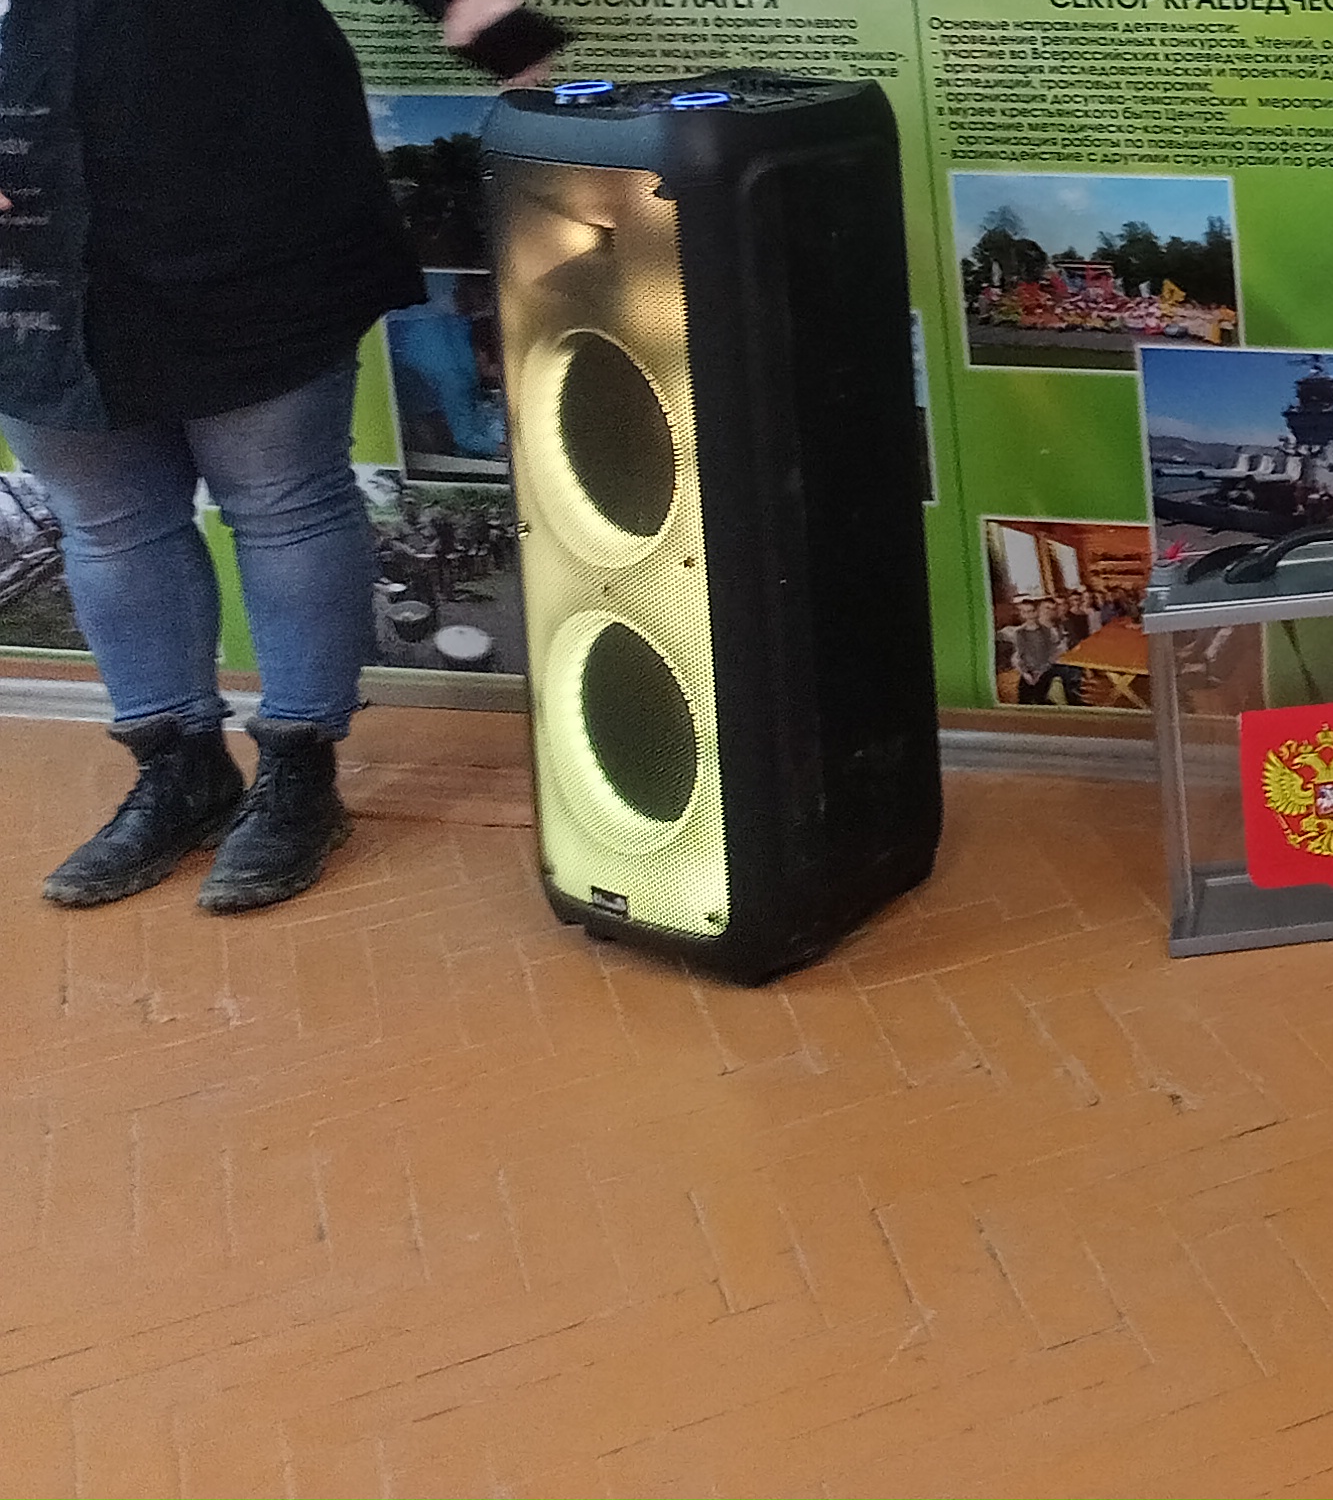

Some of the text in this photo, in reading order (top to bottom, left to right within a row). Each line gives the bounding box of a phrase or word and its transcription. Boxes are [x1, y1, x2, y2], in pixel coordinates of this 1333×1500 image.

[929, 16, 1009, 30] Основные
[1013, 20, 1119, 32] направления
[944, 64, 1044, 76] организация
[1048, 64, 1212, 77] исследовательской
